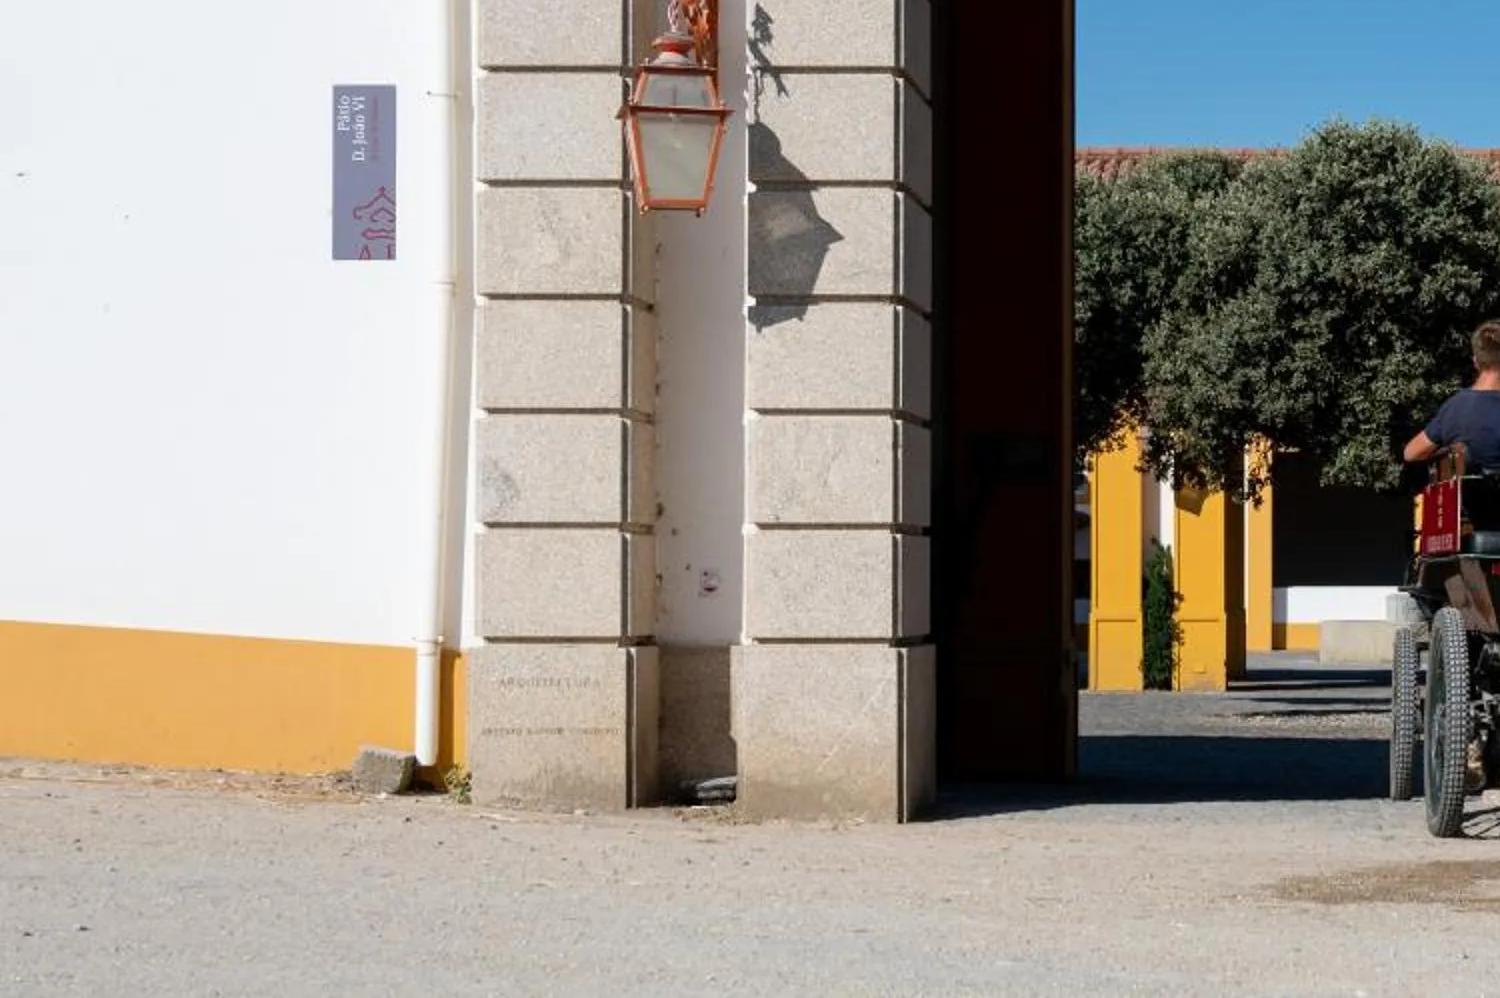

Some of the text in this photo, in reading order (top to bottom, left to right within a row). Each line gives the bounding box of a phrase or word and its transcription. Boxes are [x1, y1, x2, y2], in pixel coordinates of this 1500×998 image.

[337, 95, 350, 132] Pátio
[352, 96, 367, 162] D. João VI
